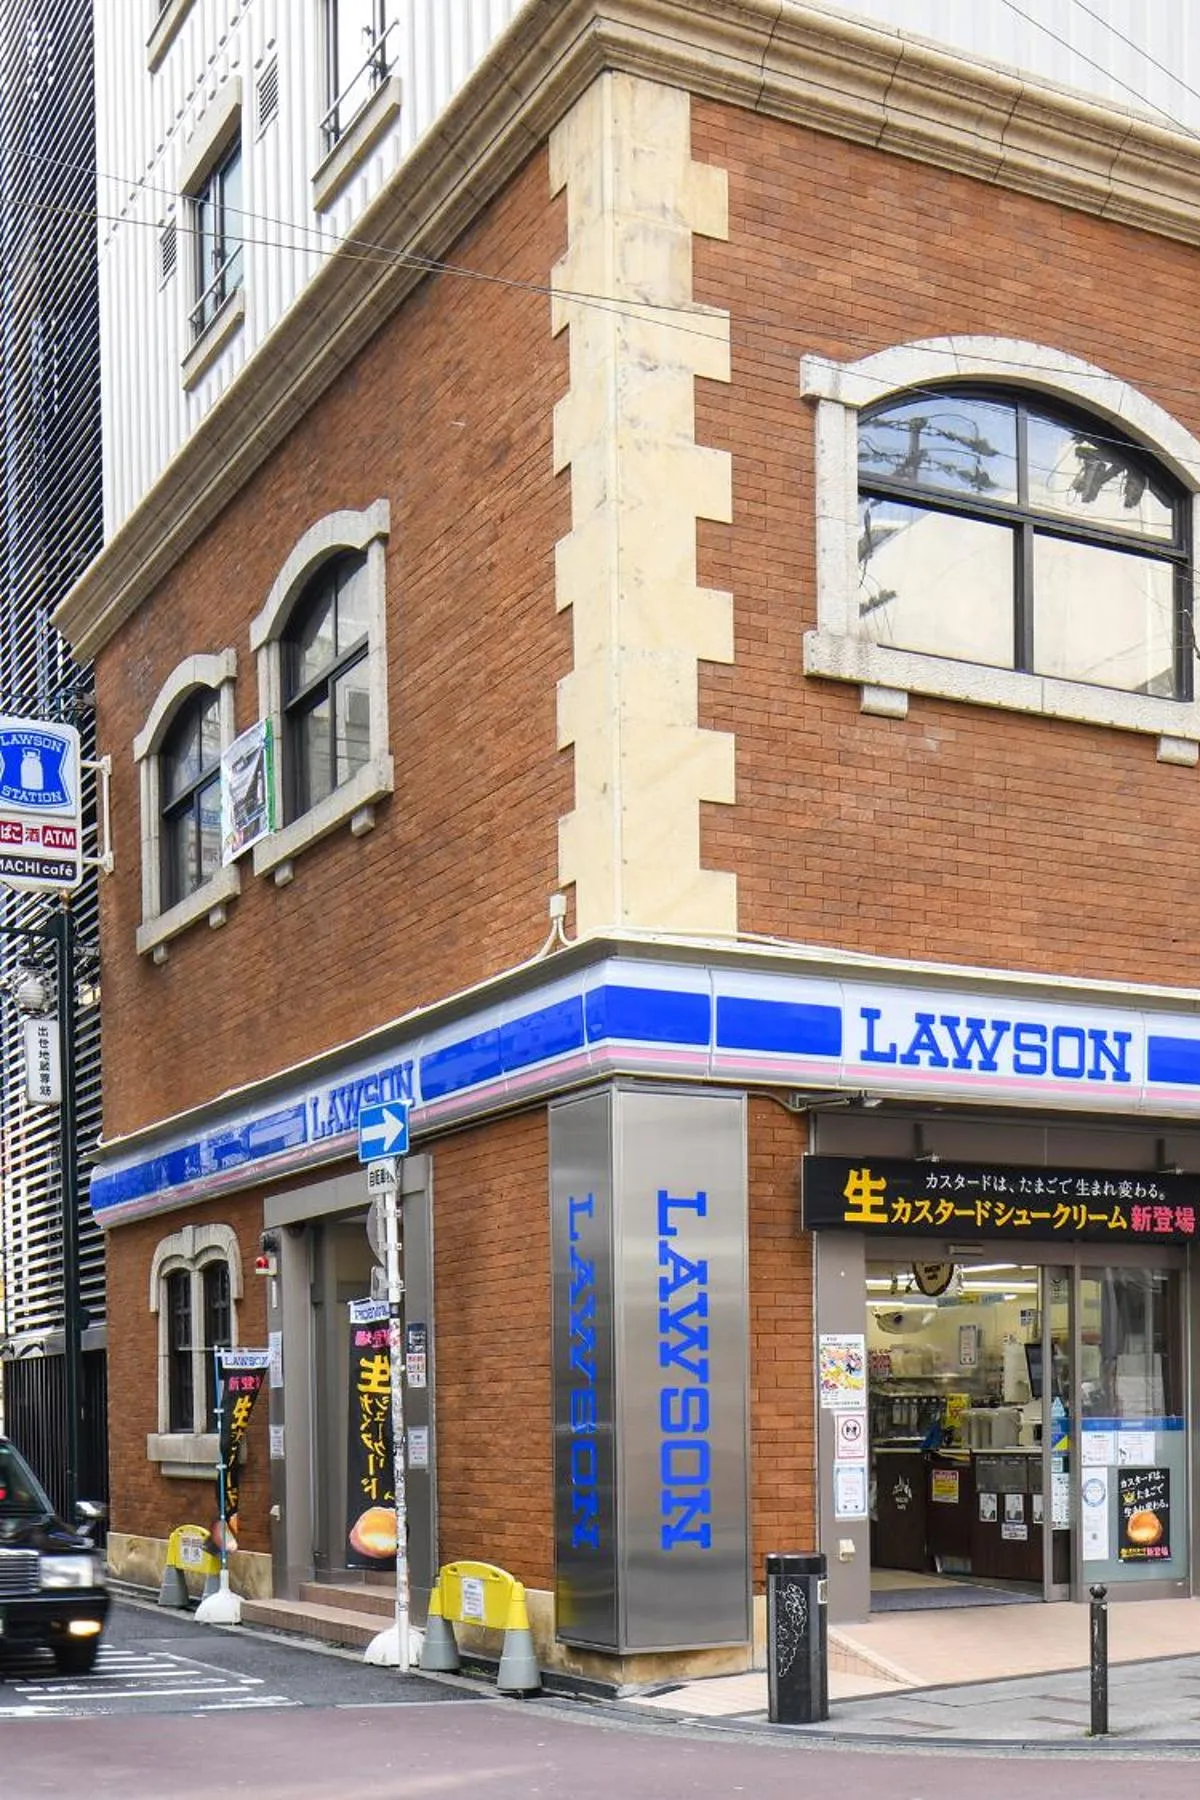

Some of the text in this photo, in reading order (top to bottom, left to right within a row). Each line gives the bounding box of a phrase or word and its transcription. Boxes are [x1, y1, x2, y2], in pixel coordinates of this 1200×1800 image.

[1, 734, 62, 753] LAWSON
[2, 785, 63, 803] STATION
[0, 824, 22, 841] ばこ
[44, 833, 75, 847] ATM
[42, 864, 73, 877] café
[860, 1007, 1132, 1082] LAWSON
[843, 1168, 1196, 1233] 生 カスタードシュークリーム 新登場
[568, 1192, 600, 1550] LAWSON
[657, 1189, 712, 1551] LAWSON
